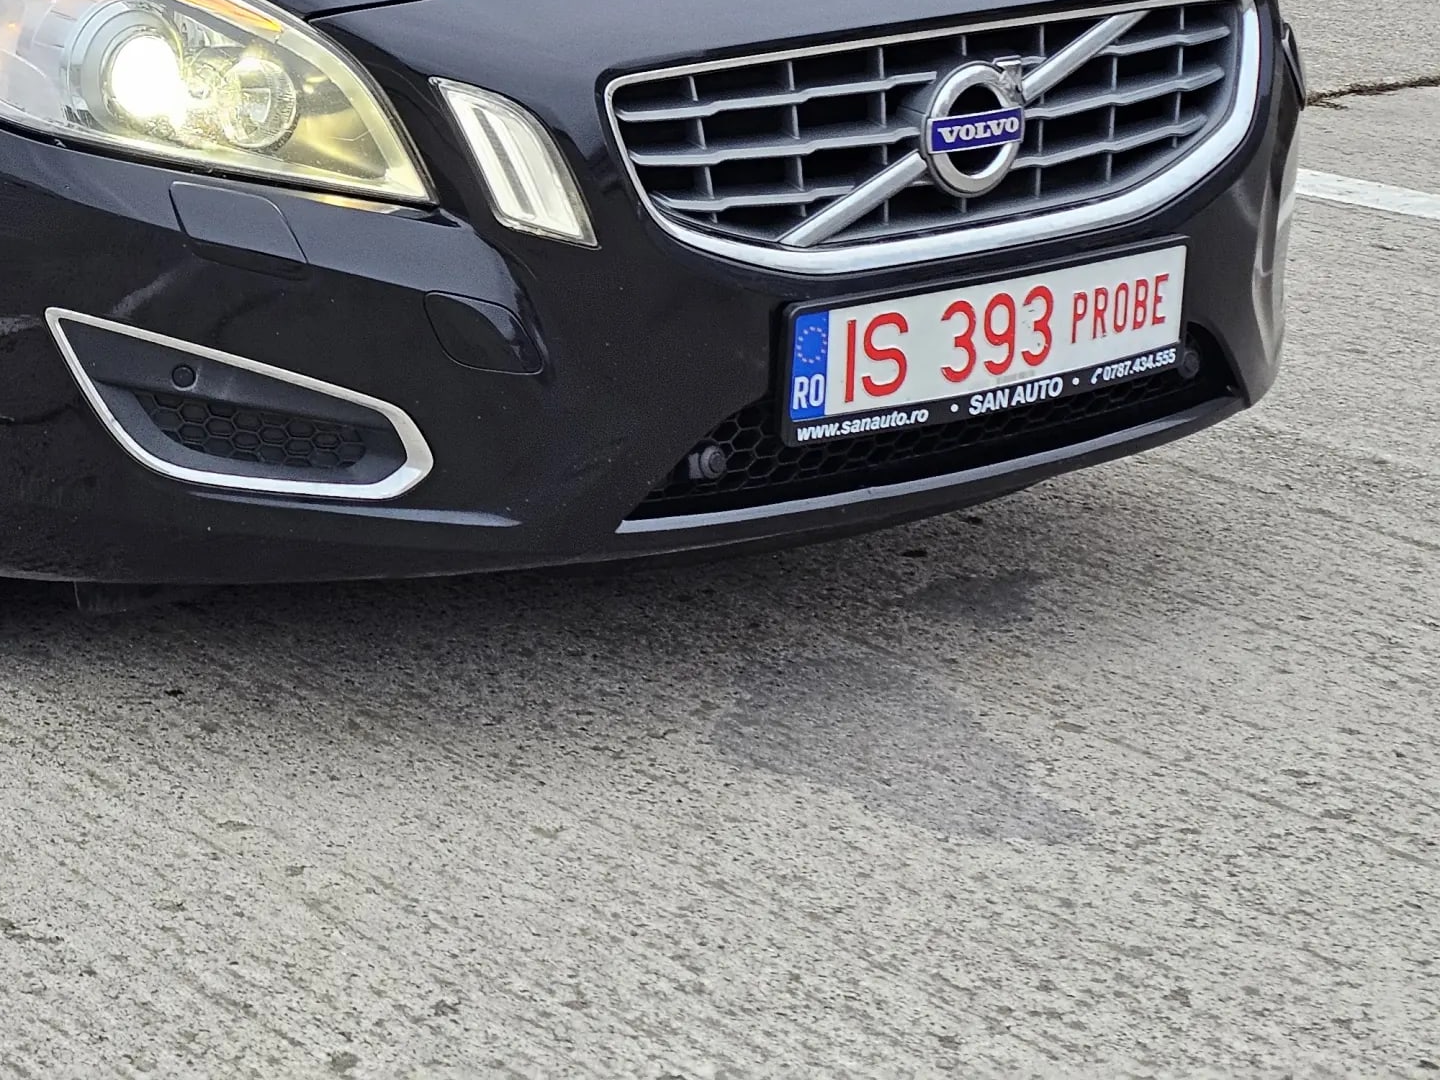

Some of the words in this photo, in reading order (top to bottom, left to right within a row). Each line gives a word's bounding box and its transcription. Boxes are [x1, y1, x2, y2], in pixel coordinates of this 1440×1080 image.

[937, 117, 1020, 143] VOLVO
[844, 311, 909, 403] IS
[941, 285, 1054, 383] 393
[1071, 273, 1170, 344] PROBE
[792, 373, 825, 410] RO
[796, 408, 929, 442] www.sanauto.ro
[968, 388, 1010, 415] SAN
[1011, 376, 1063, 406] AUTO
[1102, 348, 1177, 381] 0787.434.555
